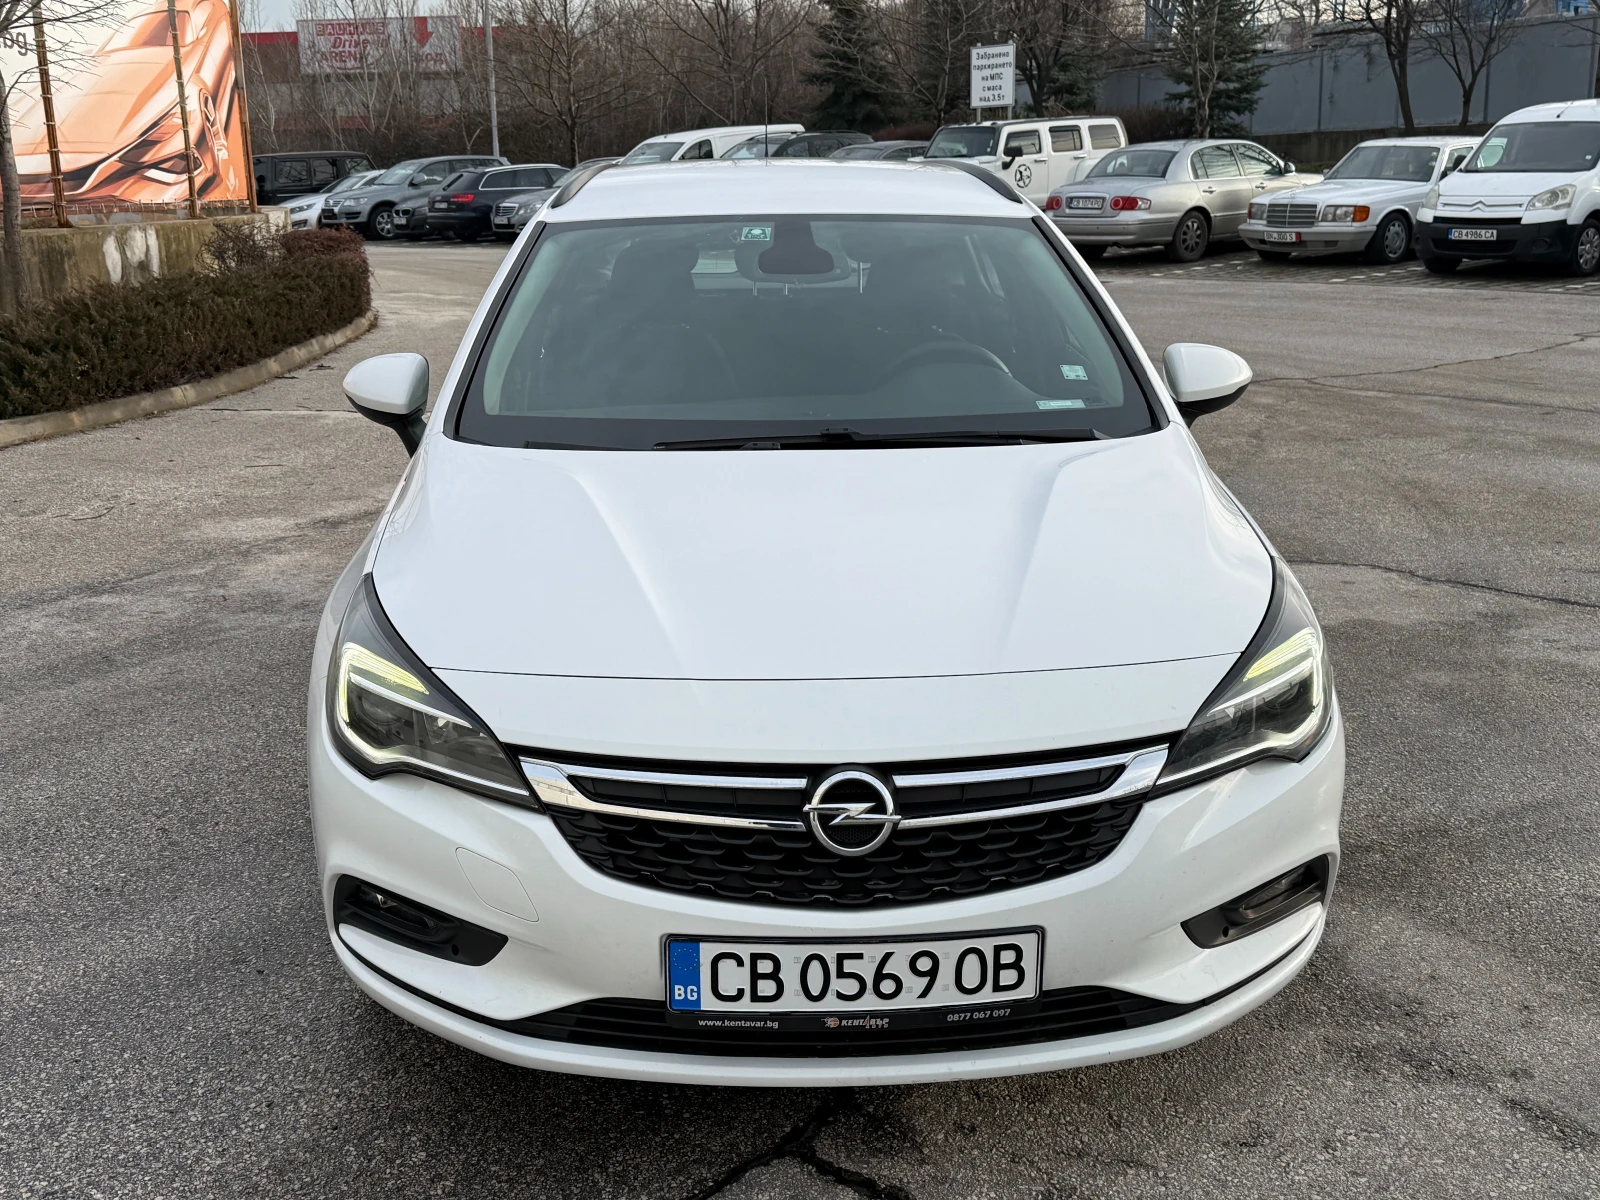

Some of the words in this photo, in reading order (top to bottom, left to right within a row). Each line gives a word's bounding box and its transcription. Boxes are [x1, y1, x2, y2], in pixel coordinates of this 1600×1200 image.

[976, 51, 1010, 61] Забранено
[973, 61, 1013, 72] паркирането
[989, 72, 1004, 81] МПС
[1484, 230, 1495, 239] CA
[674, 984, 698, 1001] BG
[710, 951, 785, 1004] CB
[799, 950, 941, 1003] 0569
[953, 942, 1026, 996] OB
[947, 1013, 971, 1022] 0877
[973, 1011, 991, 1020] 067
[993, 1009, 1011, 1018] 097
[698, 1019, 779, 1029] www.kentavar.bg
